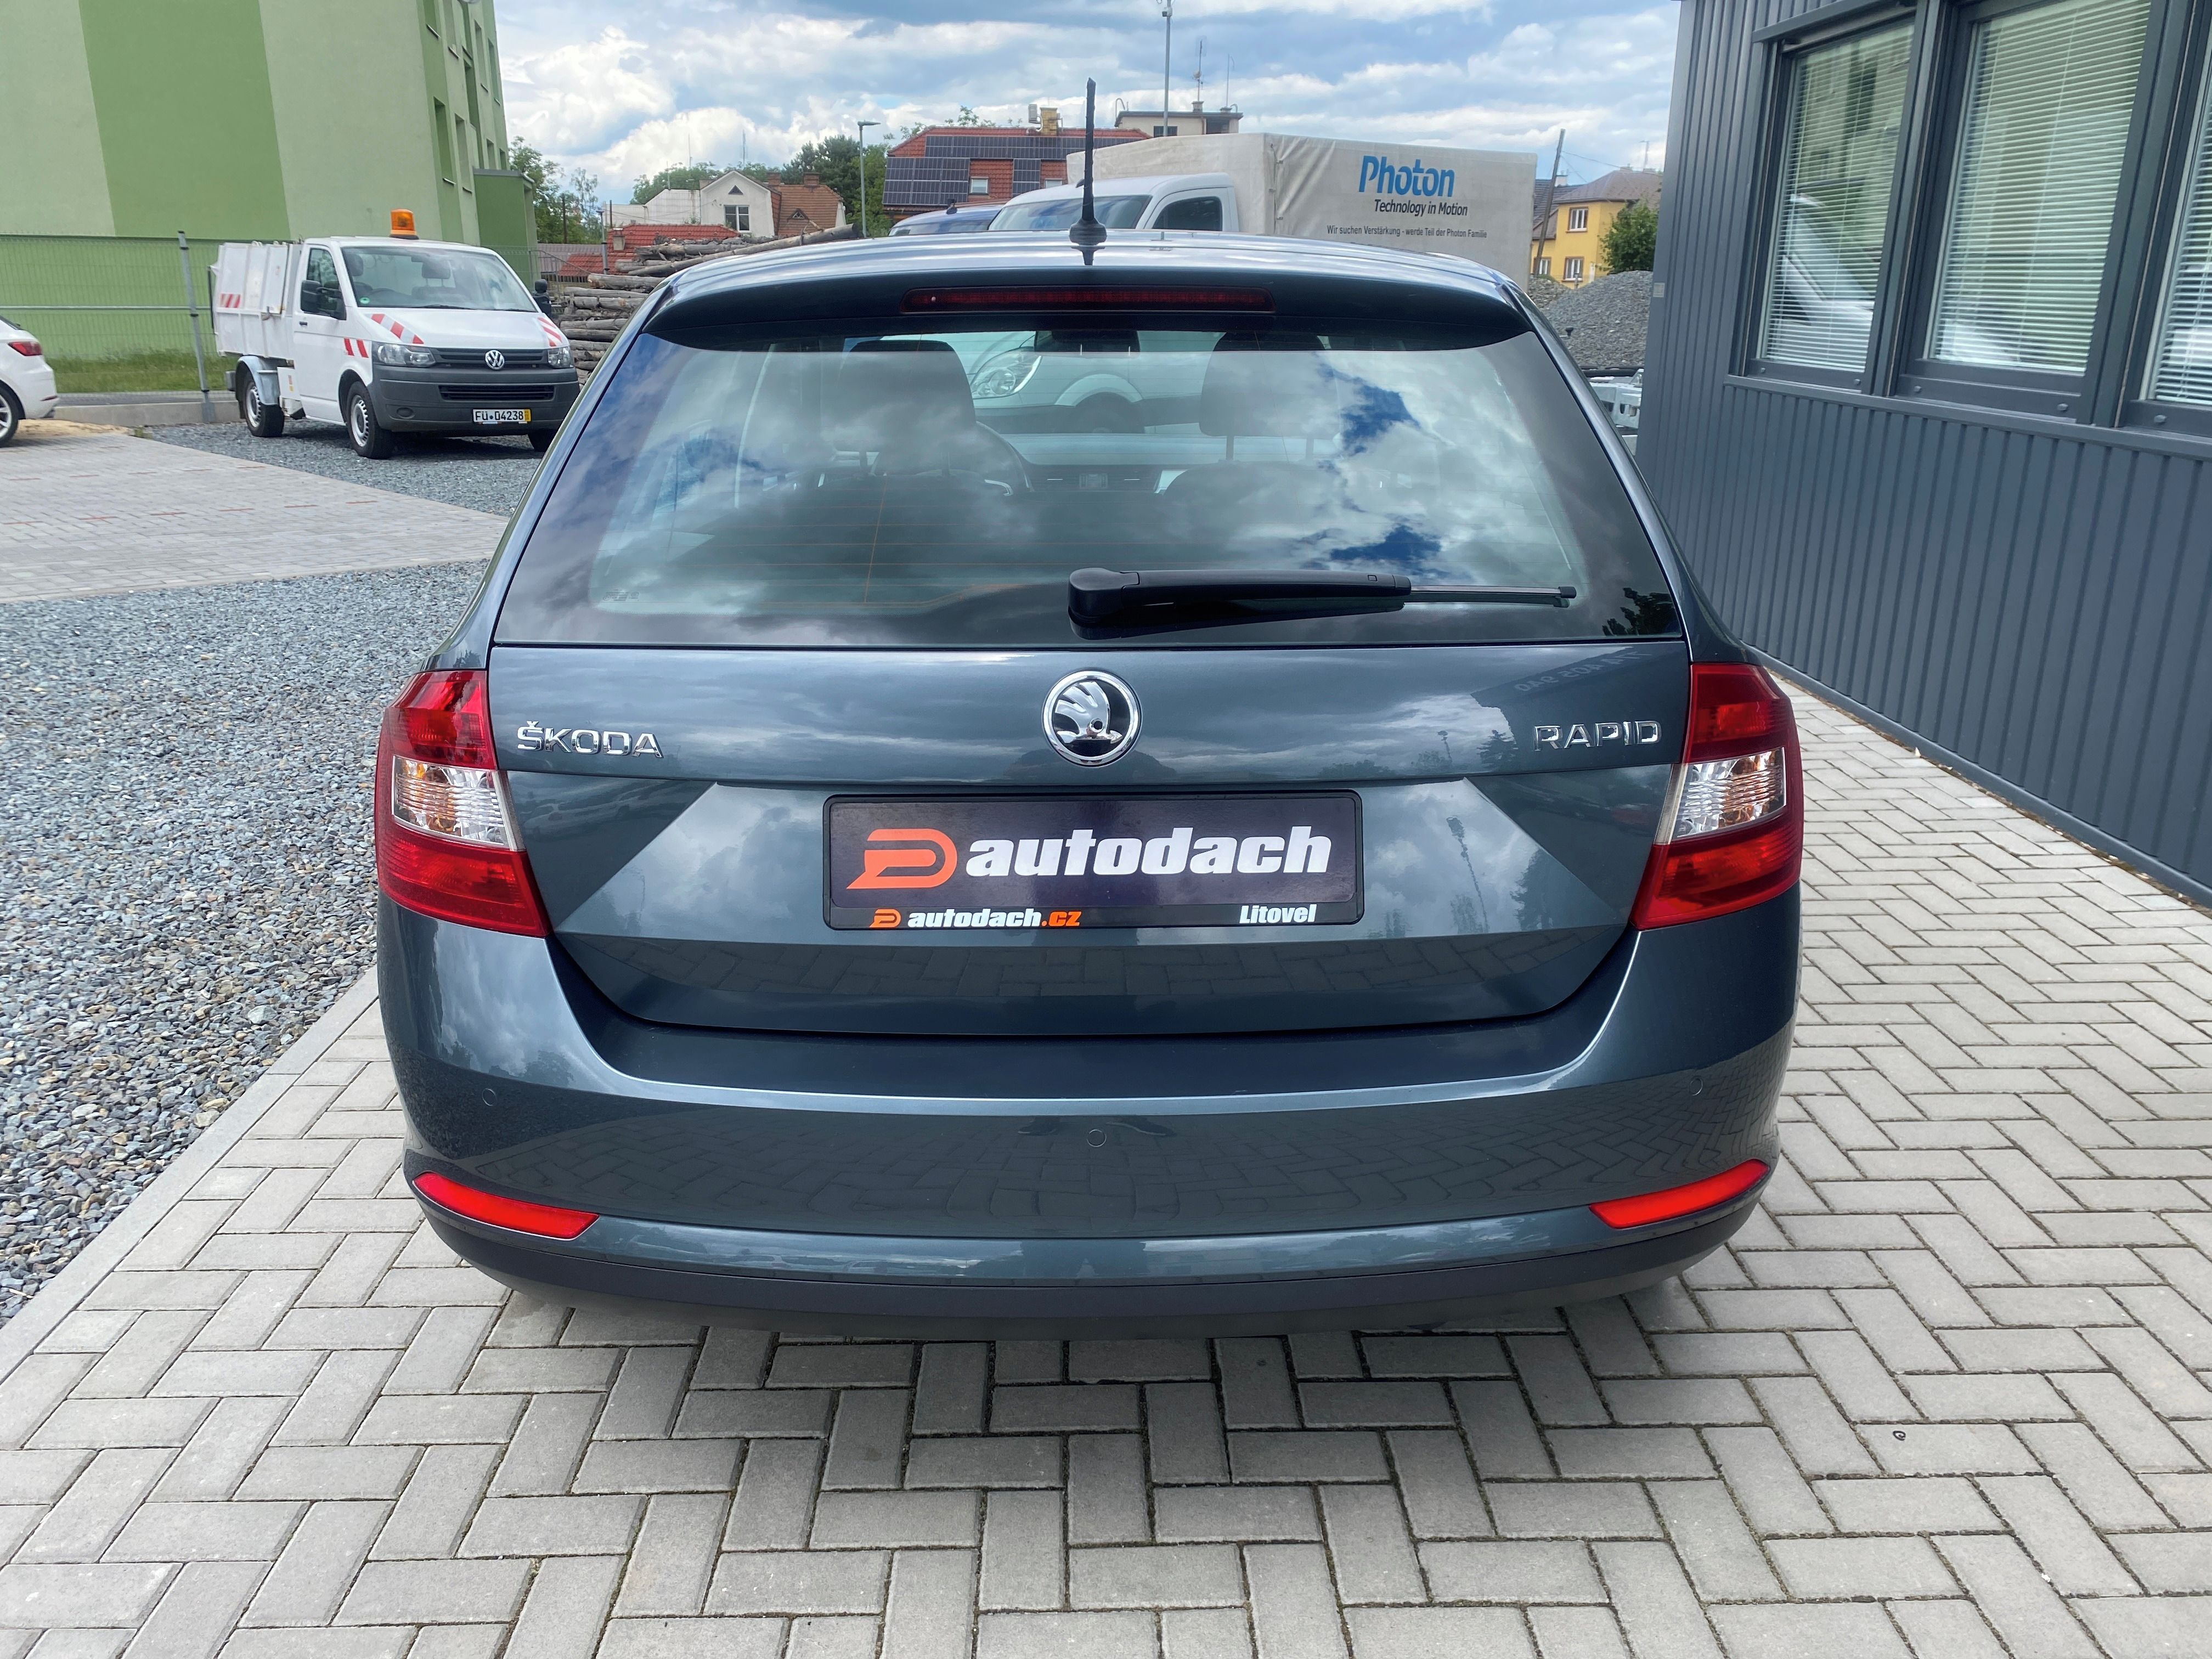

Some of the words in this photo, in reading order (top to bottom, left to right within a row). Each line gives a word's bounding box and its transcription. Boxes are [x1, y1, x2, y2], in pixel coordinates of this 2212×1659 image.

[1358, 155, 1455, 198] Photon
[1374, 199, 1426, 217] Technology
[1427, 201, 1437, 214] in
[1438, 202, 1468, 216] Motion
[1327, 225, 1338, 234] Wir
[1339, 225, 1362, 234] suchen
[1364, 225, 1401, 237] Verstärkung
[1425, 228, 1435, 236] Teil
[1447, 228, 1466, 238] Photon
[517, 720, 664, 759] ŠKODA
[1534, 720, 1662, 751] RAPID
[966, 826, 1331, 877] autodach
[907, 908, 1082, 928] autodach.cz
[1239, 904, 1317, 924] Litovel
